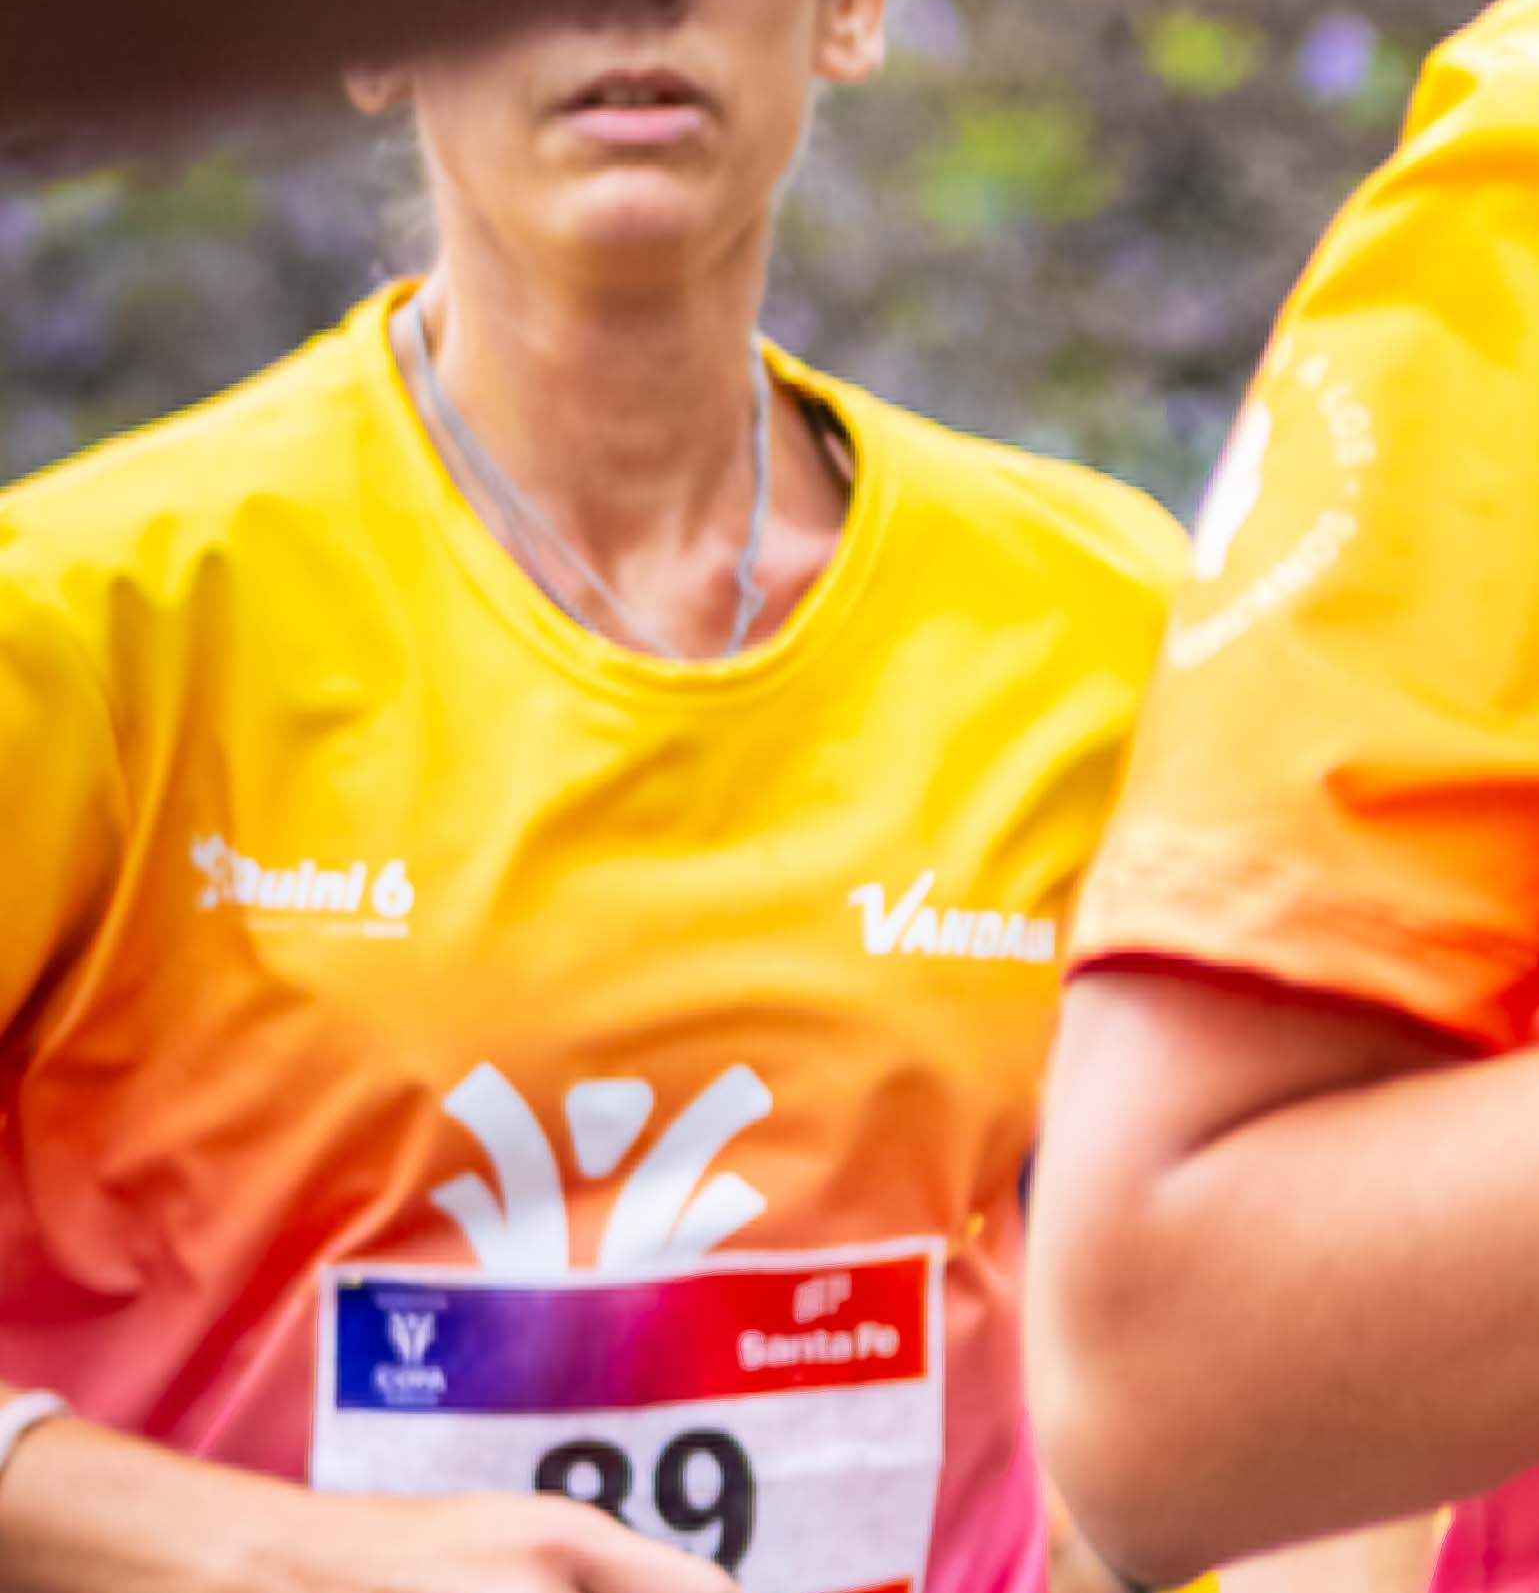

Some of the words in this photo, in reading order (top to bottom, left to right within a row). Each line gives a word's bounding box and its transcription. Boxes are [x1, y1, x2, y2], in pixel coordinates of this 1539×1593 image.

[370, 859, 416, 919] 6
[737, 1329, 853, 1371] Santa
[854, 1321, 900, 1360] Fe
